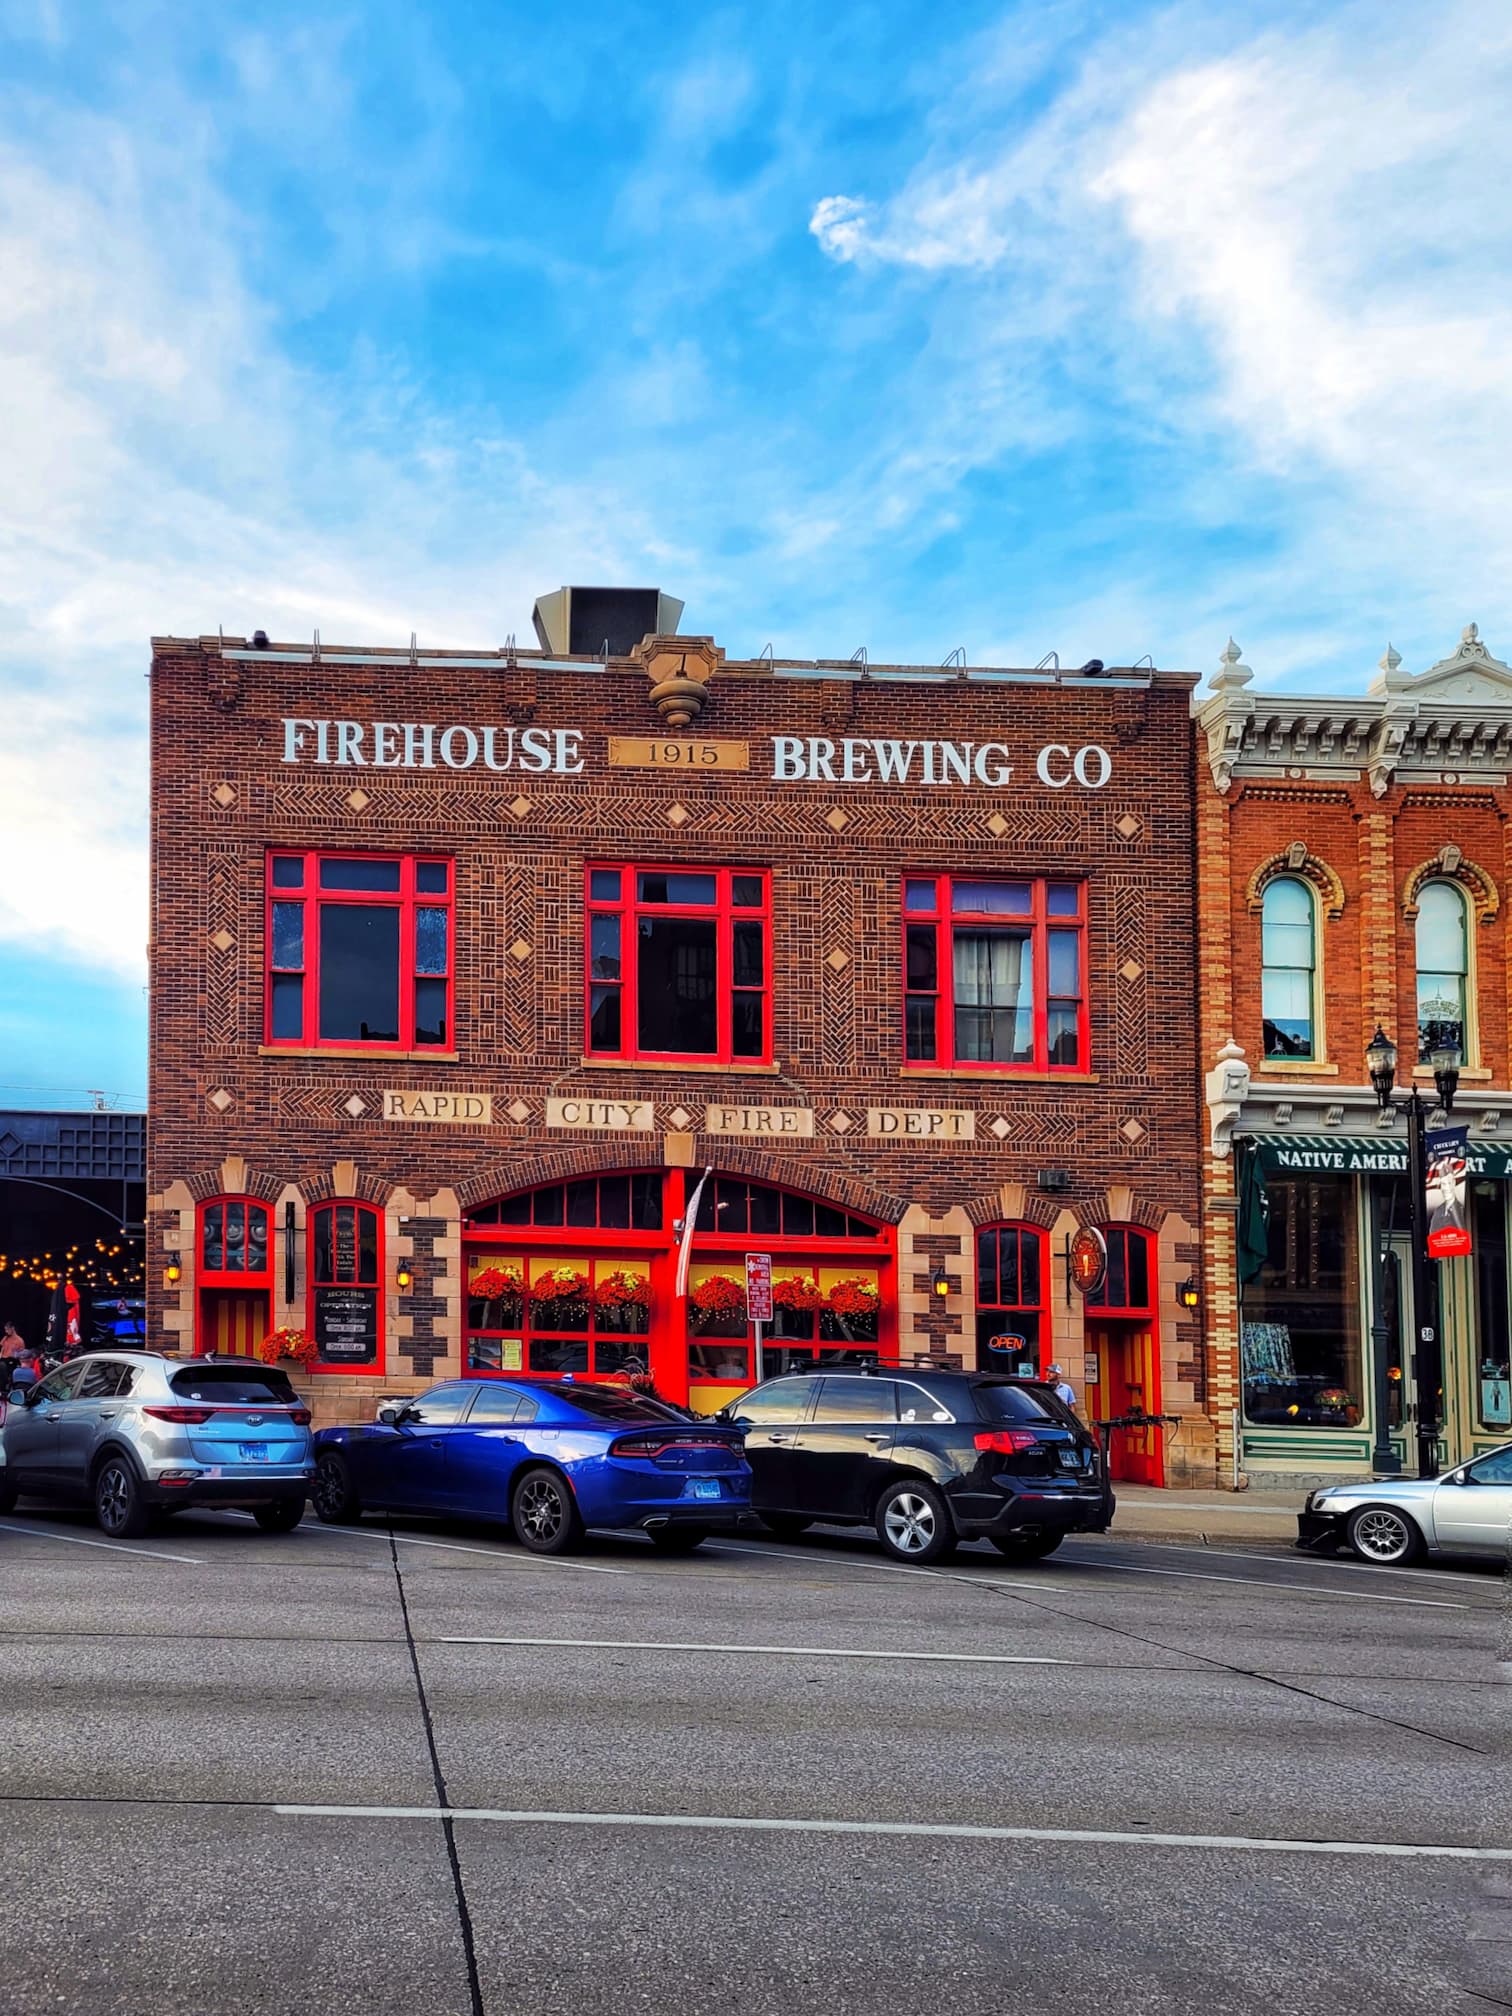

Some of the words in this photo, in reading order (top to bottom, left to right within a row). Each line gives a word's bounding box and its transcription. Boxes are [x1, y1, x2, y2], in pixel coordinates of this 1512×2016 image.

[280, 717, 586, 774] FIREHOUSE
[649, 743, 719, 765] 1915
[770, 736, 1015, 787] BREWING
[1036, 743, 1113, 789] CO
[389, 1094, 484, 1118] RAPID
[561, 1102, 642, 1126] CITY
[719, 1108, 799, 1133] FIRE
[878, 1111, 965, 1135] DEPT
[1277, 1150, 1345, 1168] NATIVE
[1349, 1153, 1409, 1171] AMERI
[989, 1336, 1023, 1350] OPEN
